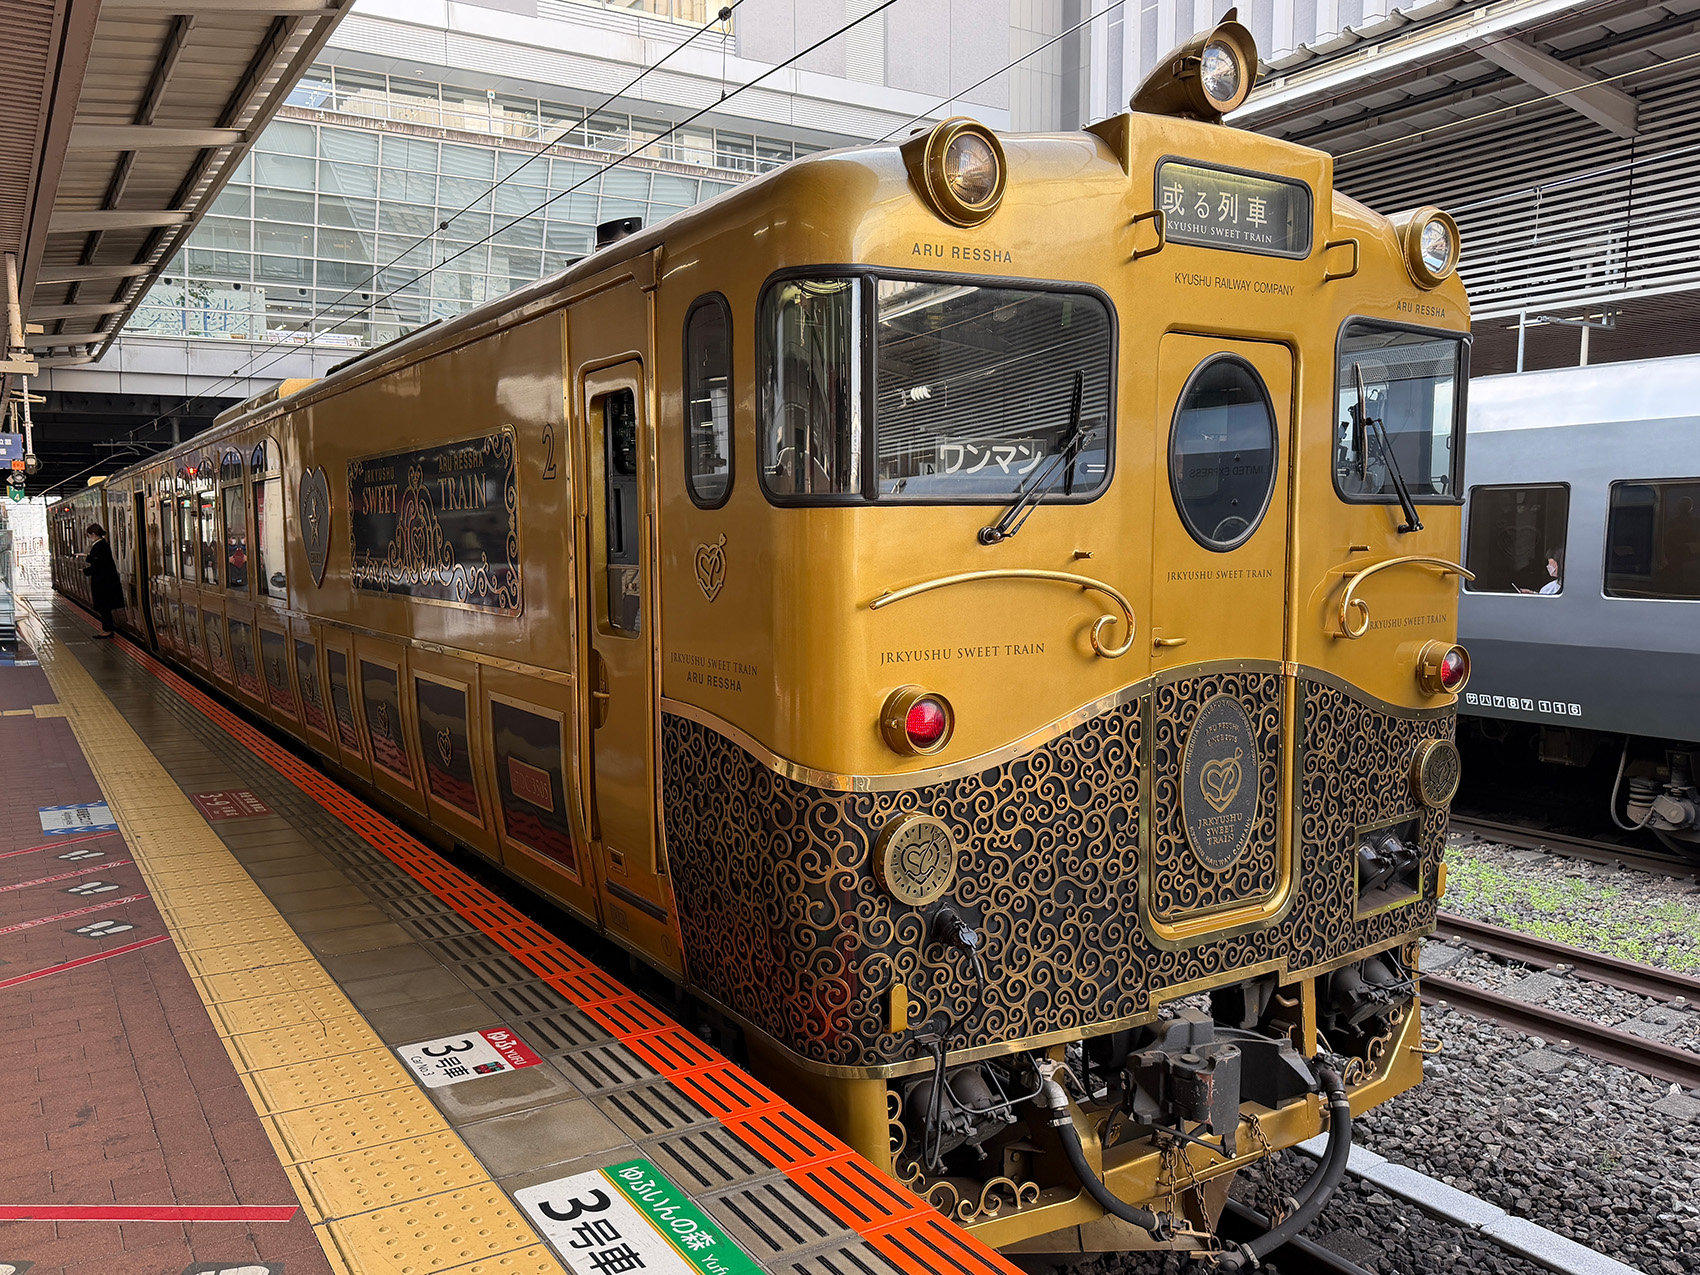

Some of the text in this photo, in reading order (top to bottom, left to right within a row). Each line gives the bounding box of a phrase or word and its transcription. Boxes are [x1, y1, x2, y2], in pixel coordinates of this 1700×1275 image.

[1161, 181, 1268, 229] 或る列車
[1167, 220, 1272, 244] KYUSHU SWEET TRAIN
[911, 242, 1013, 264] ARU RESSHA
[1174, 272, 1295, 296] KYUSHU RAILWAY COMPANY
[1396, 301, 1446, 318] ARU RESSHA
[439, 450, 484, 473] ARU RESSHA
[542, 423, 557, 480] 2
[940, 444, 1042, 474] ワンマン
[362, 484, 398, 516] SWEET
[437, 472, 487, 511] TRAIN
[1167, 569, 1272, 583] JRKYUSHU SWEET TRAIN
[1404, 616, 1425, 627] SWEET
[1427, 614, 1447, 625] TRAIN
[670, 651, 758, 677] JRKYUSHU SWEET TRAIN
[880, 642, 1045, 666] JRKYUSHU SWEET TRAIN
[687, 670, 742, 693] ARU RESSHA
[1538, 700, 1582, 716] 116
[1197, 812, 1243, 830] JRKYUSHU
[1206, 824, 1235, 837] SWEET
[1206, 833, 1234, 846] TRAIN
[422, 1040, 474, 1079] 3号車
[487, 1030, 527, 1066] ゆふ YUFU
[618, 1166, 716, 1252] ゆふいんの森
[538, 1188, 647, 1275] 3号車
